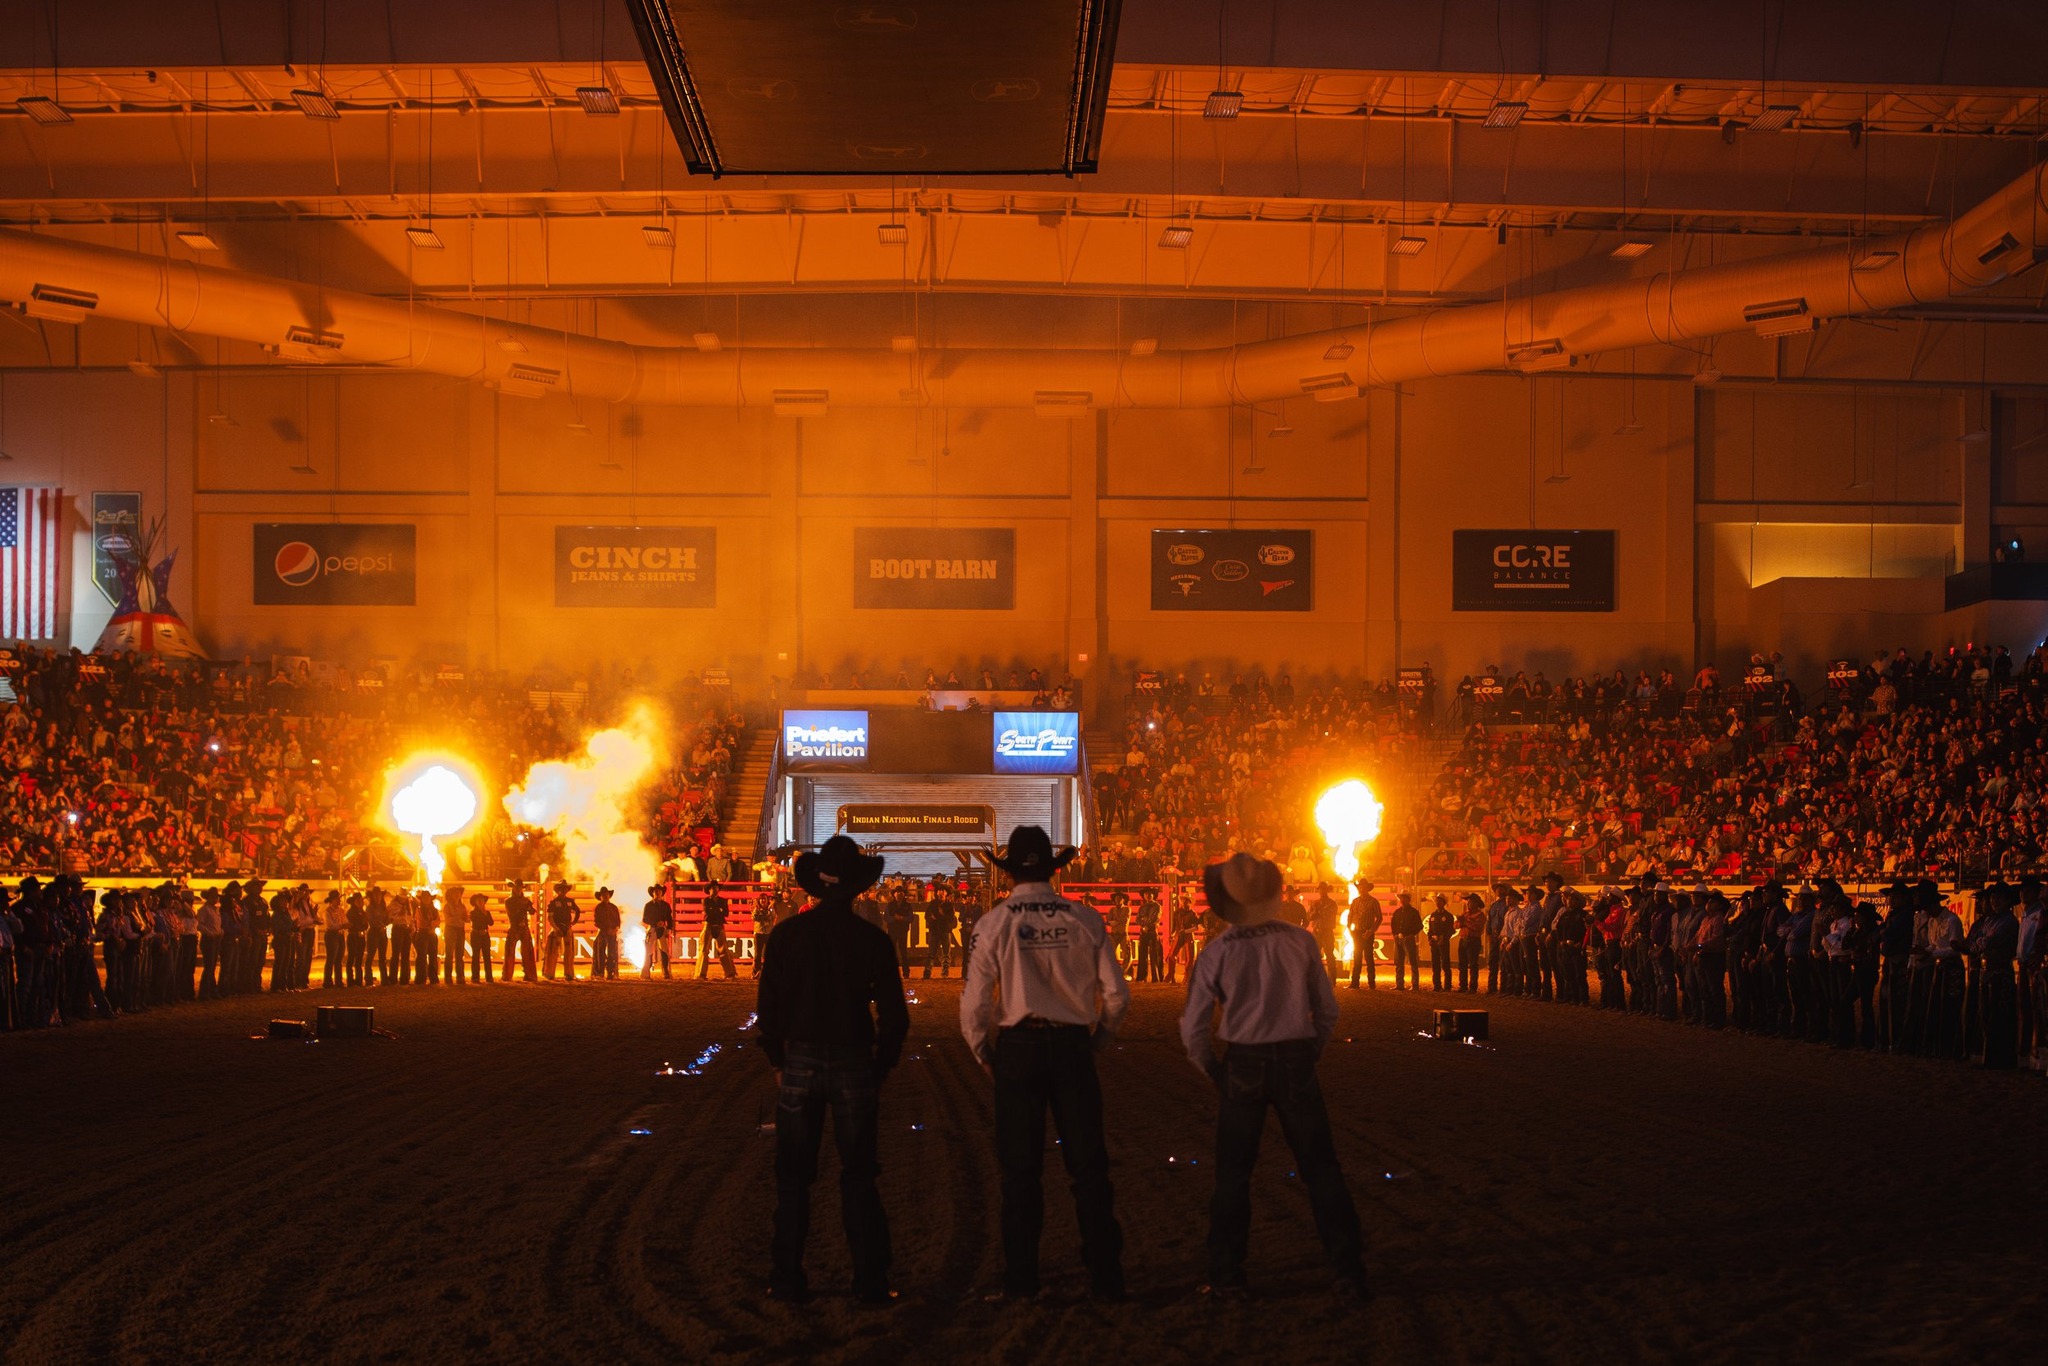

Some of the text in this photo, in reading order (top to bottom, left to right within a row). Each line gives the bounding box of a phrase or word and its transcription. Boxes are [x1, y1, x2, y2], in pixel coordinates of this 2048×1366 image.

[569, 546, 697, 569] CINCH
[1272, 554, 1289, 562] GEAR
[1493, 545, 1571, 568] CORE
[324, 552, 393, 576] pepsi
[870, 559, 997, 579] BOOT BARN
[571, 571, 697, 583] JEANS & SHIRTS
[1493, 572, 1571, 580] BALANCE
[0, 659, 20, 668] 20
[1744, 675, 1773, 684] 102
[1828, 669, 1858, 679] 103
[1473, 686, 1503, 694] 102
[786, 724, 865, 742] Priefert
[786, 741, 865, 757] Pavilion
[1007, 901, 1071, 918] Wrangler
